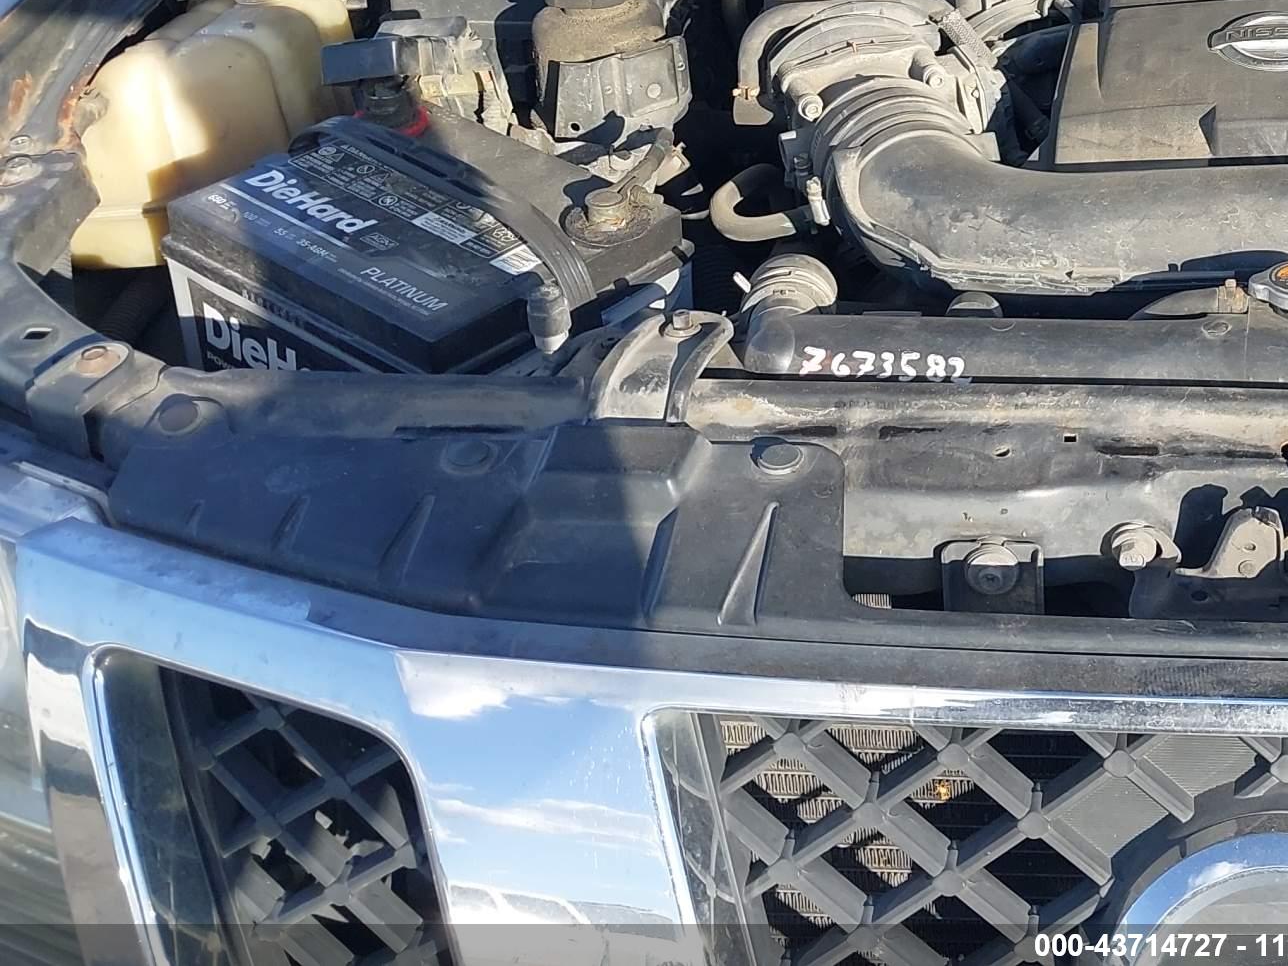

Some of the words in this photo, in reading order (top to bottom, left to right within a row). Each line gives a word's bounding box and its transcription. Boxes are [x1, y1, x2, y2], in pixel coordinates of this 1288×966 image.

[244, 169, 378, 233] DieHard
[359, 266, 449, 312] PLATINUM
[202, 300, 312, 372] DieH
